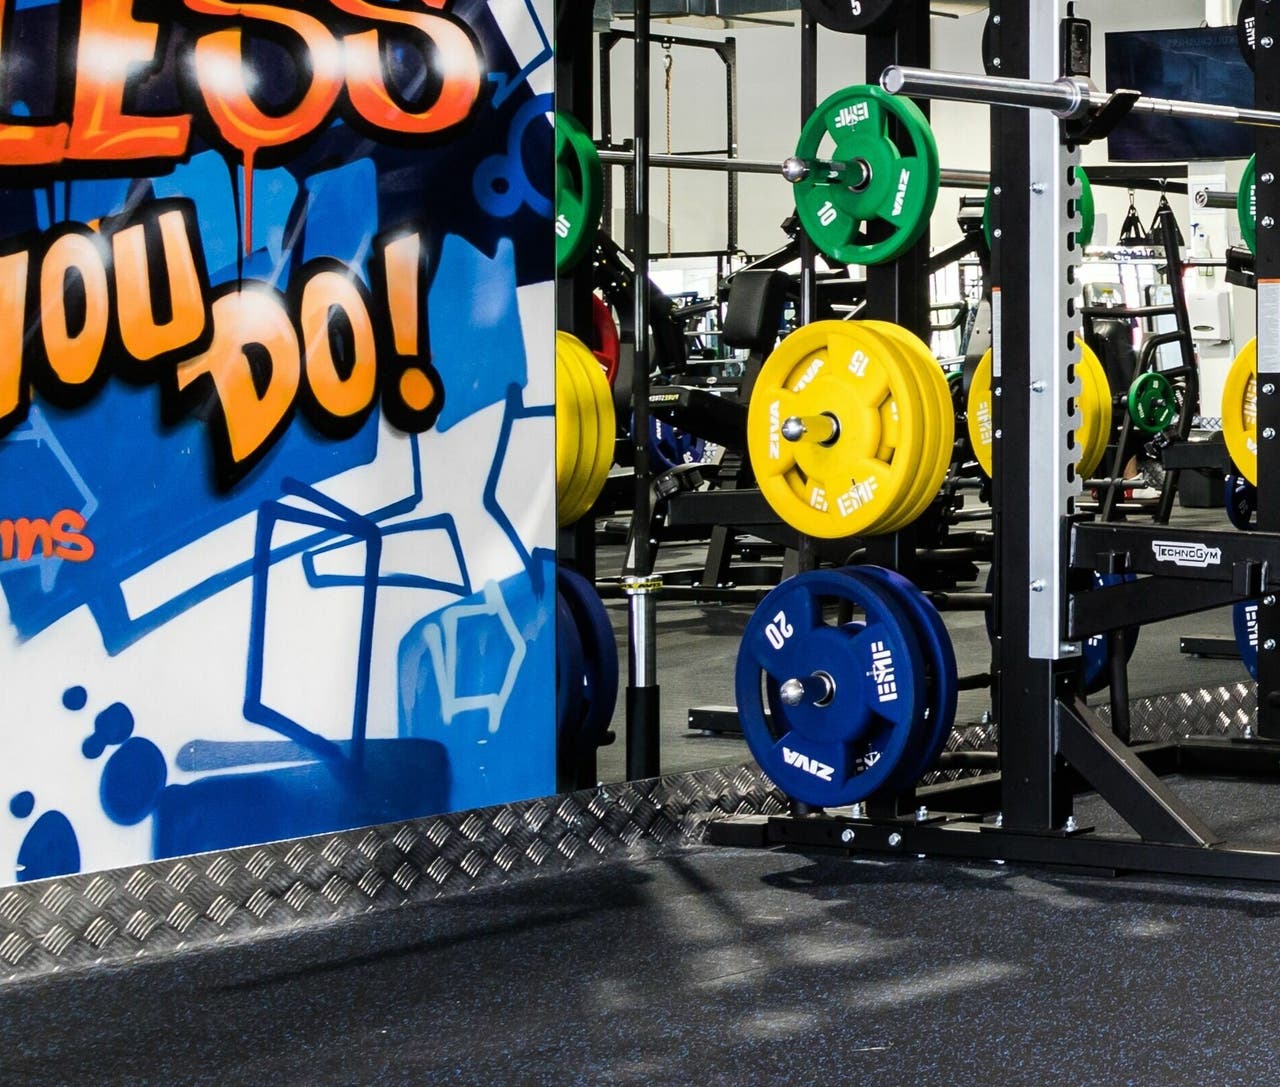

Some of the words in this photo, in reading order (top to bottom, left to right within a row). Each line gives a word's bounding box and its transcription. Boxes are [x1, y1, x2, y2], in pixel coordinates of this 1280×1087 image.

[891, 168, 910, 216] ZIVA
[817, 200, 838, 227] 10
[178, 233, 436, 464] DO!
[848, 350, 870, 377] 15
[769, 400, 781, 460] ZIVA
[1153, 543, 1219, 563] TECHNOGYM
[764, 610, 794, 650] 20
[782, 746, 836, 782] ZIVA
